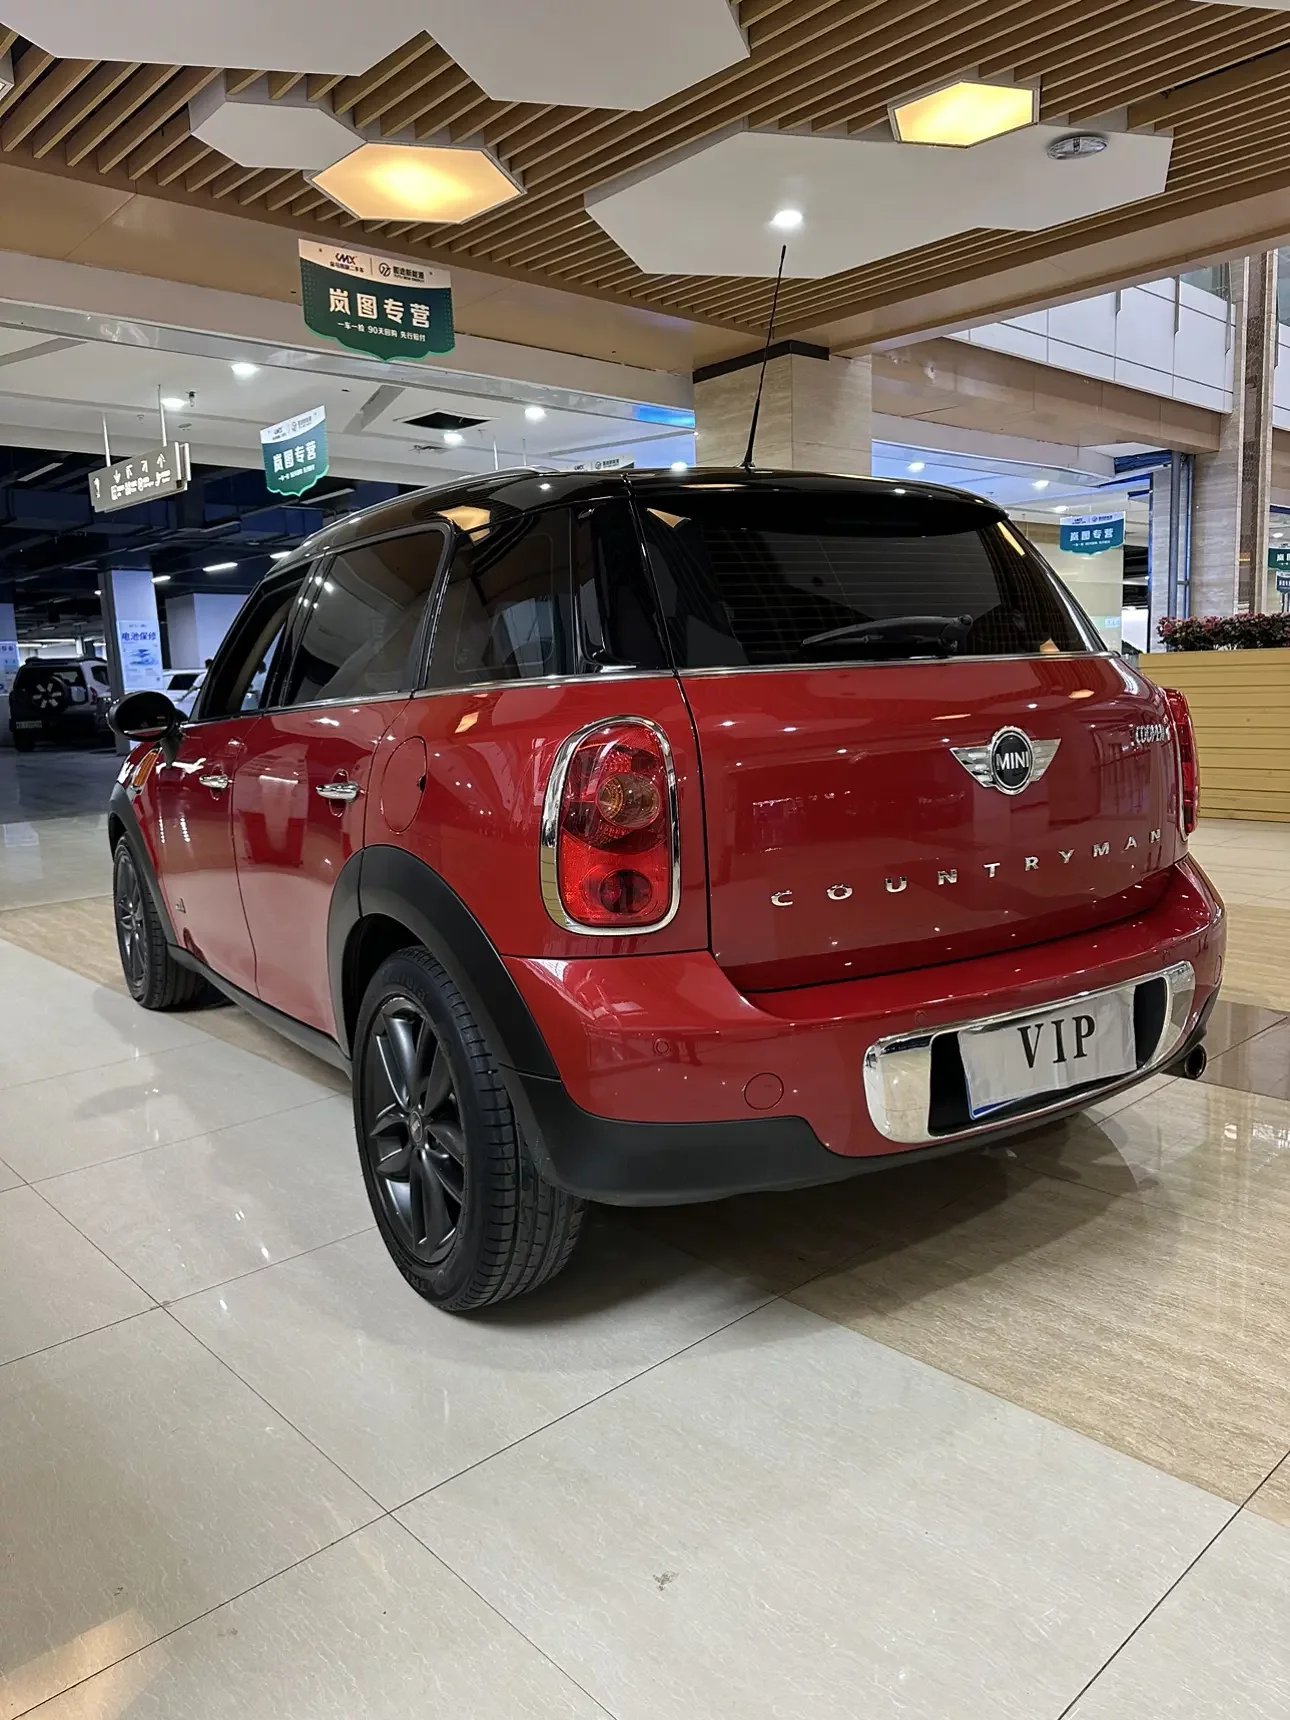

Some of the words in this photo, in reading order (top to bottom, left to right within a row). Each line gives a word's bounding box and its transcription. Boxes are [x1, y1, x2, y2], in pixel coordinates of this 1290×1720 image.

[329, 287, 430, 328] 岚图专营
[272, 440, 317, 473] 岚图专营
[1069, 528, 1114, 542] 岚图专营
[121, 631, 157, 642] 电池保修
[996, 751, 1029, 770] MINI
[770, 829, 1161, 907] COUNTRYMAN
[1017, 1014, 1096, 1069] VIP
